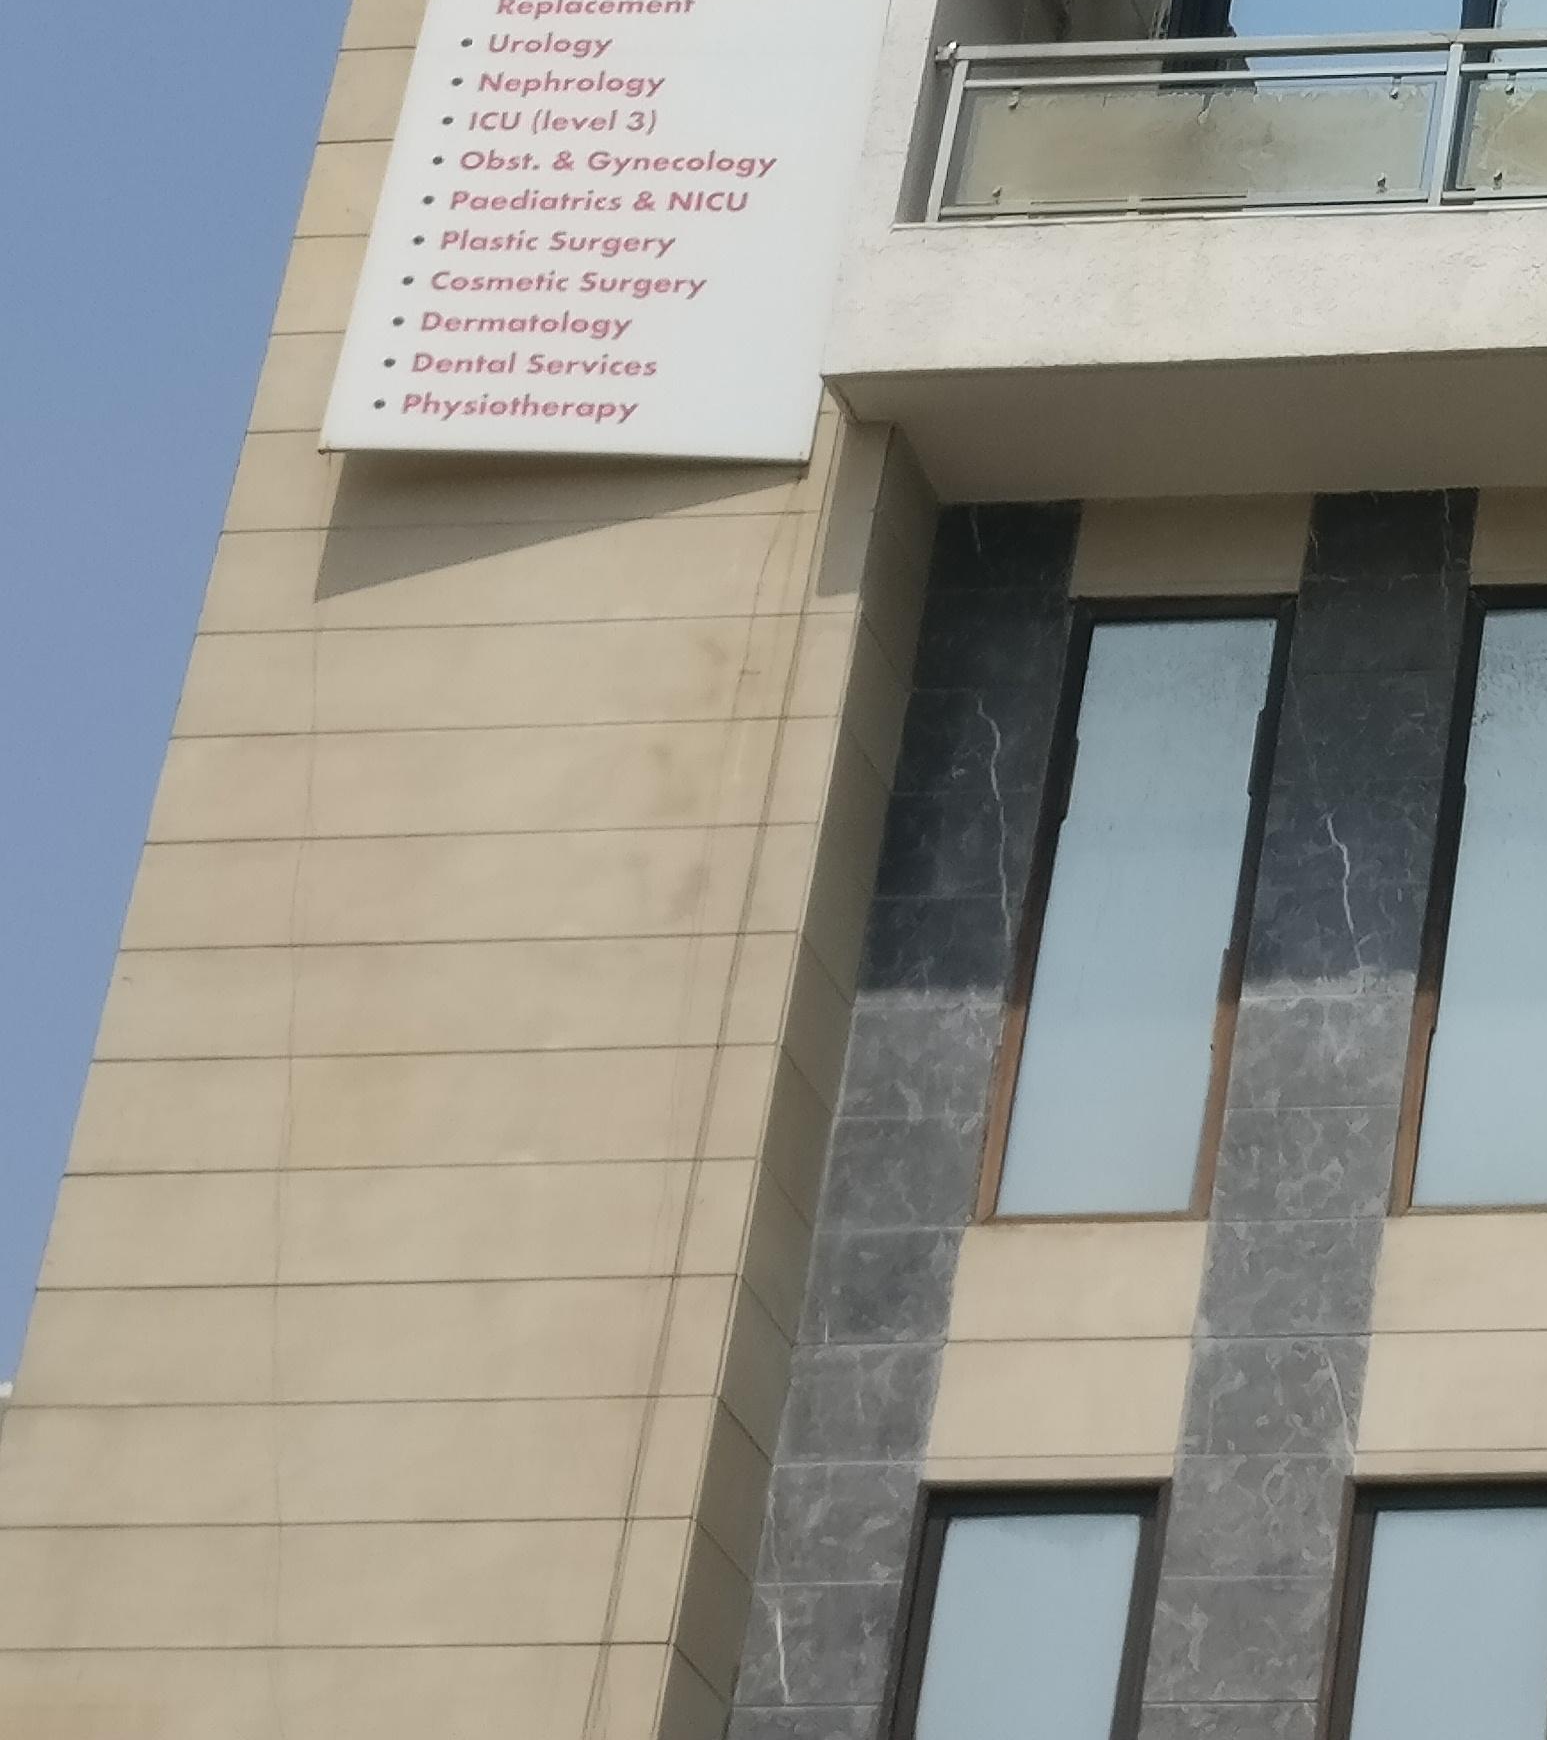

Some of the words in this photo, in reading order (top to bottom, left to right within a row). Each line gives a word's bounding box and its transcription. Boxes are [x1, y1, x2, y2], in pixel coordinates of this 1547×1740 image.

[487, 32, 614, 61] Urology
[476, 71, 666, 100] Nephrology
[467, 110, 522, 133] ICU
[530, 109, 618, 135] (level
[625, 110, 659, 135] 3)
[459, 149, 542, 174] Obst.
[552, 149, 576, 174] &
[585, 149, 778, 180] Gynecology
[449, 189, 623, 213] Paediatrics
[632, 190, 656, 213] &
[666, 190, 749, 214] NICU
[439, 229, 539, 253] Plastic
[548, 229, 677, 260] Surgery
[429, 269, 569, 294] Cosmetic
[579, 270, 708, 300] Surgery
[419, 310, 635, 341] Dermatology
[410, 351, 518, 377] Dental
[525, 352, 659, 379] Services
[402, 392, 640, 424] Physiotherapy
